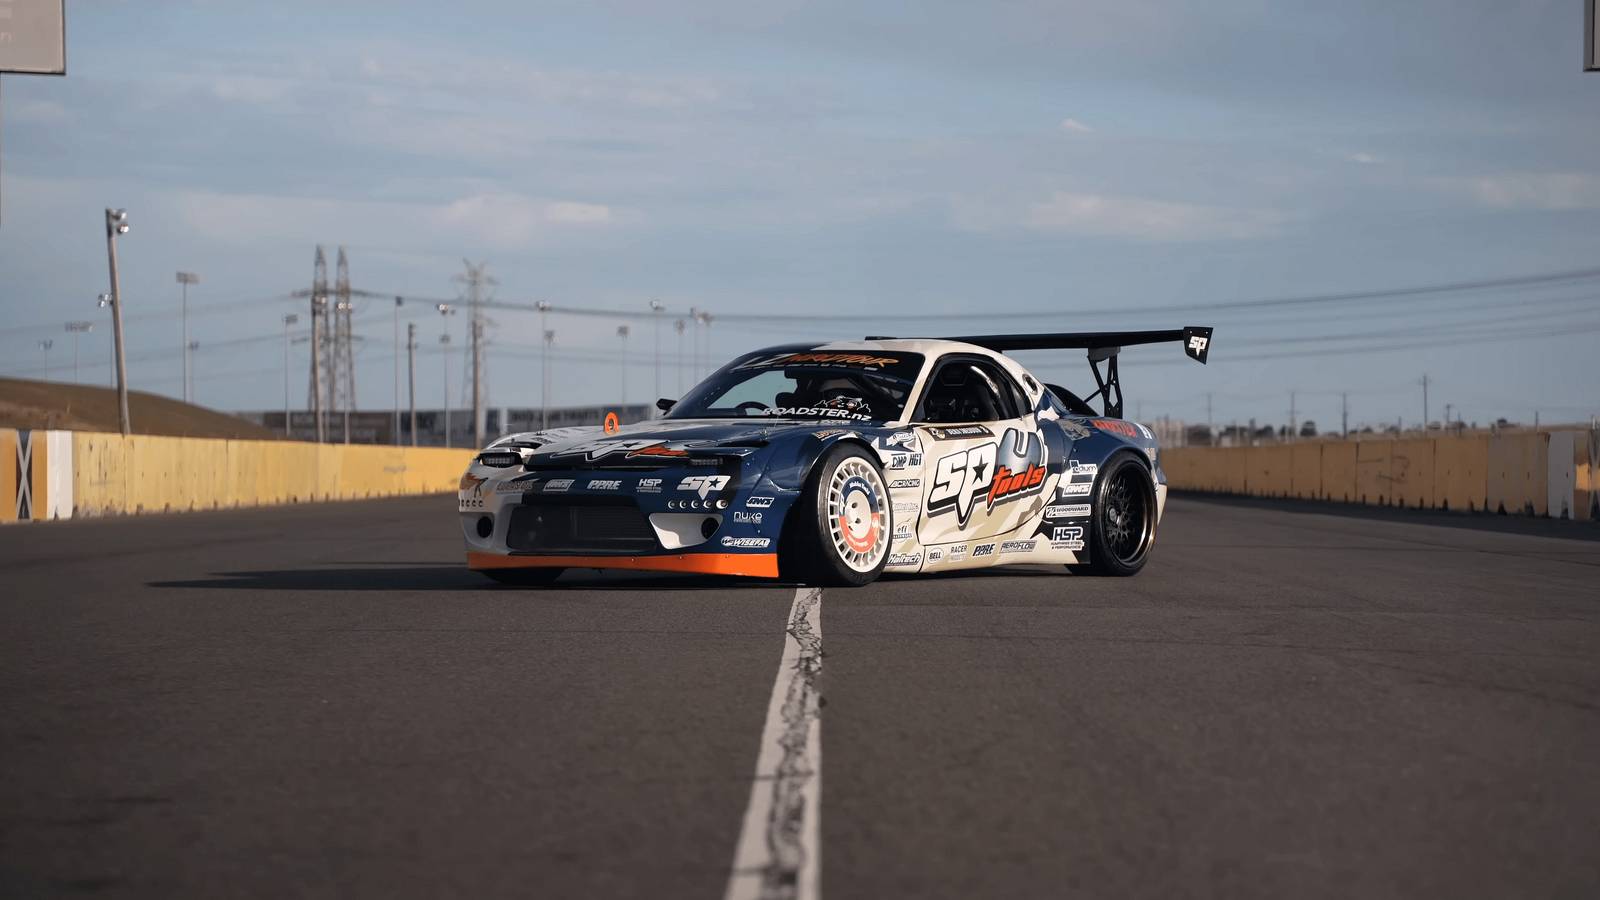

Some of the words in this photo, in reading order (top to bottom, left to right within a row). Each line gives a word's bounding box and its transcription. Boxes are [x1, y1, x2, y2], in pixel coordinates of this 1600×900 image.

[1189, 336, 1208, 356] SP
[760, 407, 872, 421] ROADSTER.nz
[677, 475, 731, 500] SP
[928, 441, 997, 522] SP
[987, 463, 1046, 509] tools
[1053, 527, 1082, 540] HSP
